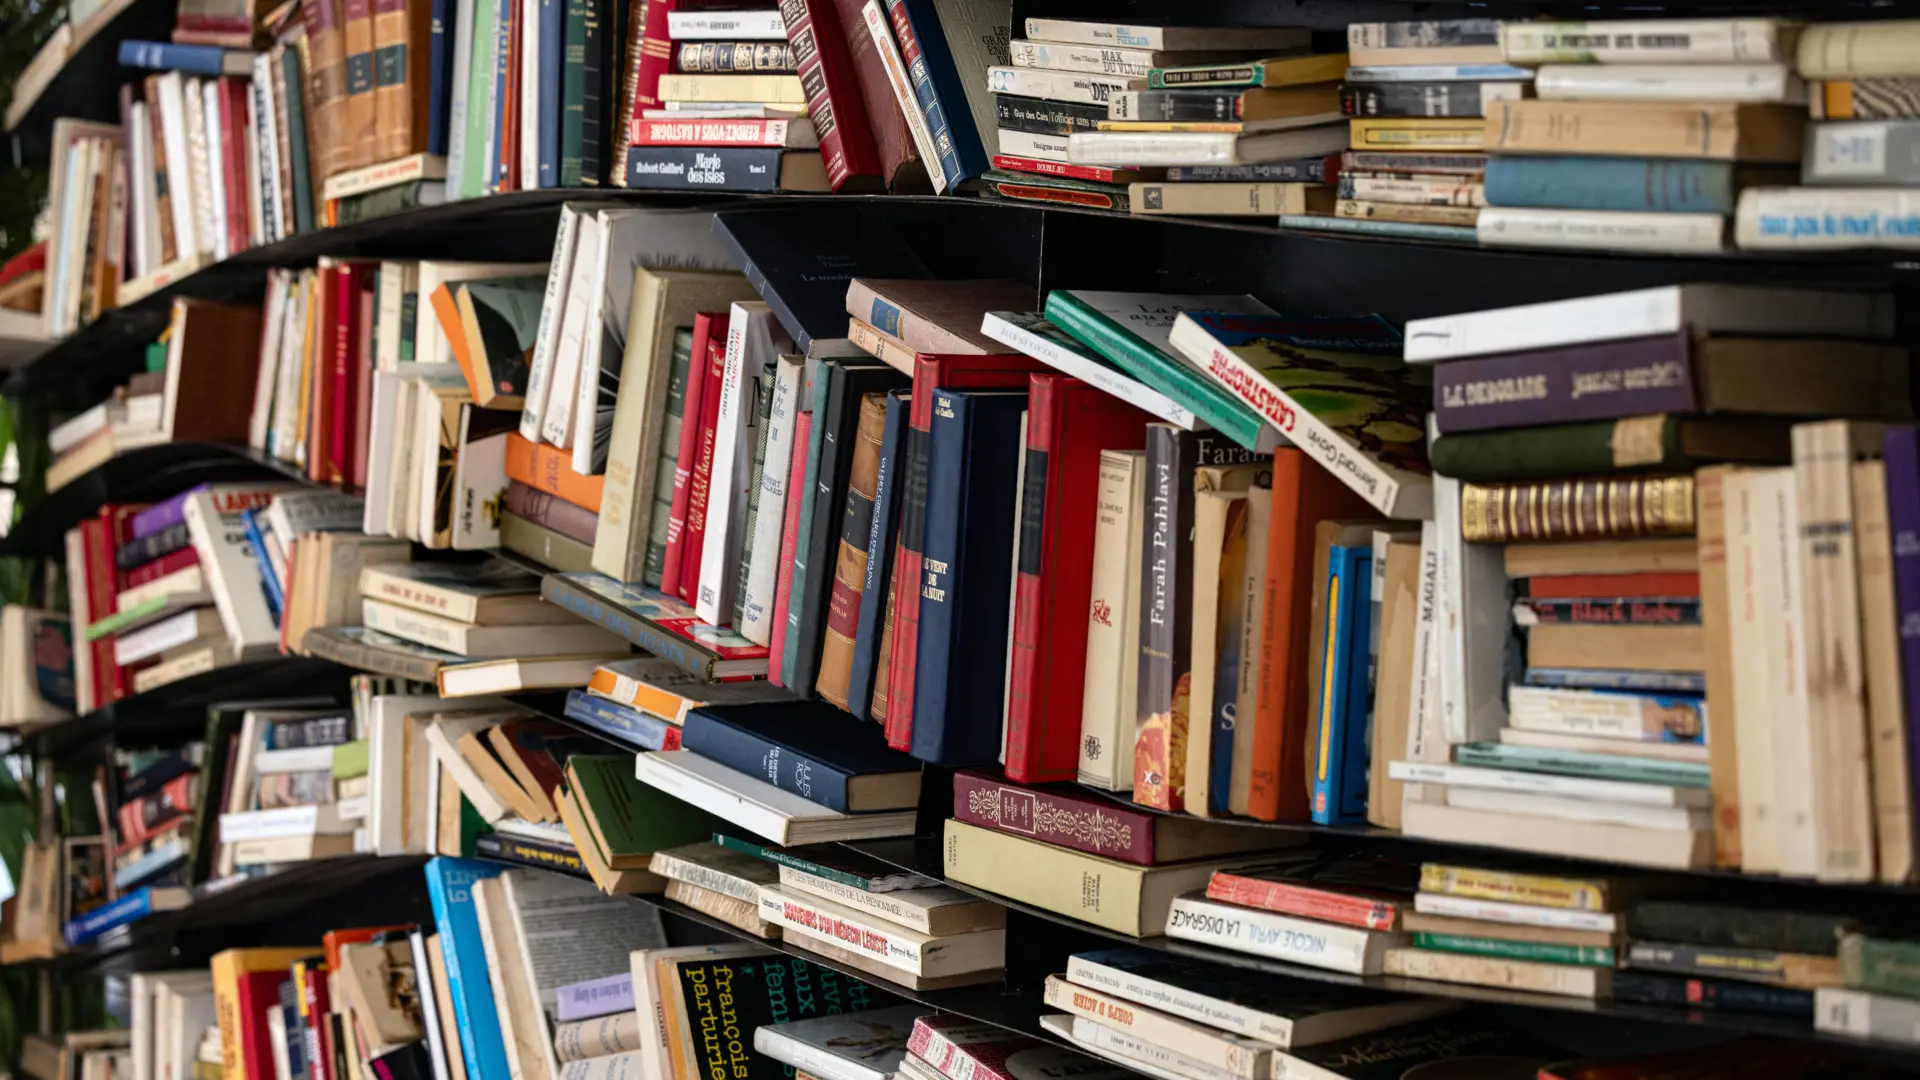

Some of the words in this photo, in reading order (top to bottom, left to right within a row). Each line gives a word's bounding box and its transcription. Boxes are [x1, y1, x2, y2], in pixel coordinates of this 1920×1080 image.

[982, 36, 1010, 46] GRAN
[1101, 51, 1123, 63] MAX
[1103, 62, 1117, 73] DU
[1014, 109, 1025, 120] Guy
[1025, 111, 1036, 121] des
[1035, 111, 1049, 122] Cars
[1076, 117, 1089, 126] sans
[650, 124, 693, 140] BASTOGNE
[701, 125, 760, 141] RENDEZ-VOUS
[636, 161, 659, 174] Robert
[694, 152, 721, 169] Marie
[1036, 162, 1055, 173] DOUBLE
[1055, 165, 1066, 174] JEU
[687, 168, 703, 184] des
[703, 168, 725, 184] Isles
[730, 328, 742, 389] FAROUCHE
[720, 378, 731, 418] JUDITH
[1208, 349, 1296, 433] CATASTROPHE
[701, 427, 713, 477] MAUVE
[876, 456, 887, 496] VALERY
[698, 480, 708, 507] TAXI
[1153, 463, 1169, 549] Pahlavi
[695, 513, 703, 531] UN
[872, 497, 882, 538] GISCARD
[866, 539, 877, 591] D'ESTAING
[930, 558, 948, 575] VENT
[928, 573, 937, 586] DE
[928, 586, 945, 602] NUIT
[1150, 557, 1167, 627] Farah
[1571, 601, 1624, 623] Black
[795, 762, 804, 791] ROY
[803, 760, 812, 799] JULES
[794, 872, 807, 883] LES
[806, 874, 846, 898] TROMPETTES
[846, 887, 856, 901] DE
[856, 891, 866, 904] LA
[866, 894, 902, 916] RENOMMÉE
[782, 901, 818, 930] SOUVENIRS
[818, 913, 833, 937] D'UN
[834, 918, 861, 946] MÉDECIN
[861, 926, 889, 956] LÉGISTE
[1171, 909, 1223, 935] DISGRACE
[1227, 920, 1241, 938] LA
[1250, 923, 1280, 941] AVRIL
[1281, 929, 1327, 953] NICOLE
[791, 958, 816, 1015] aux
[1073, 992, 1096, 1014] ACIER
[685, 967, 725, 1080] parturie
[1107, 1004, 1133, 1026] CORPS
